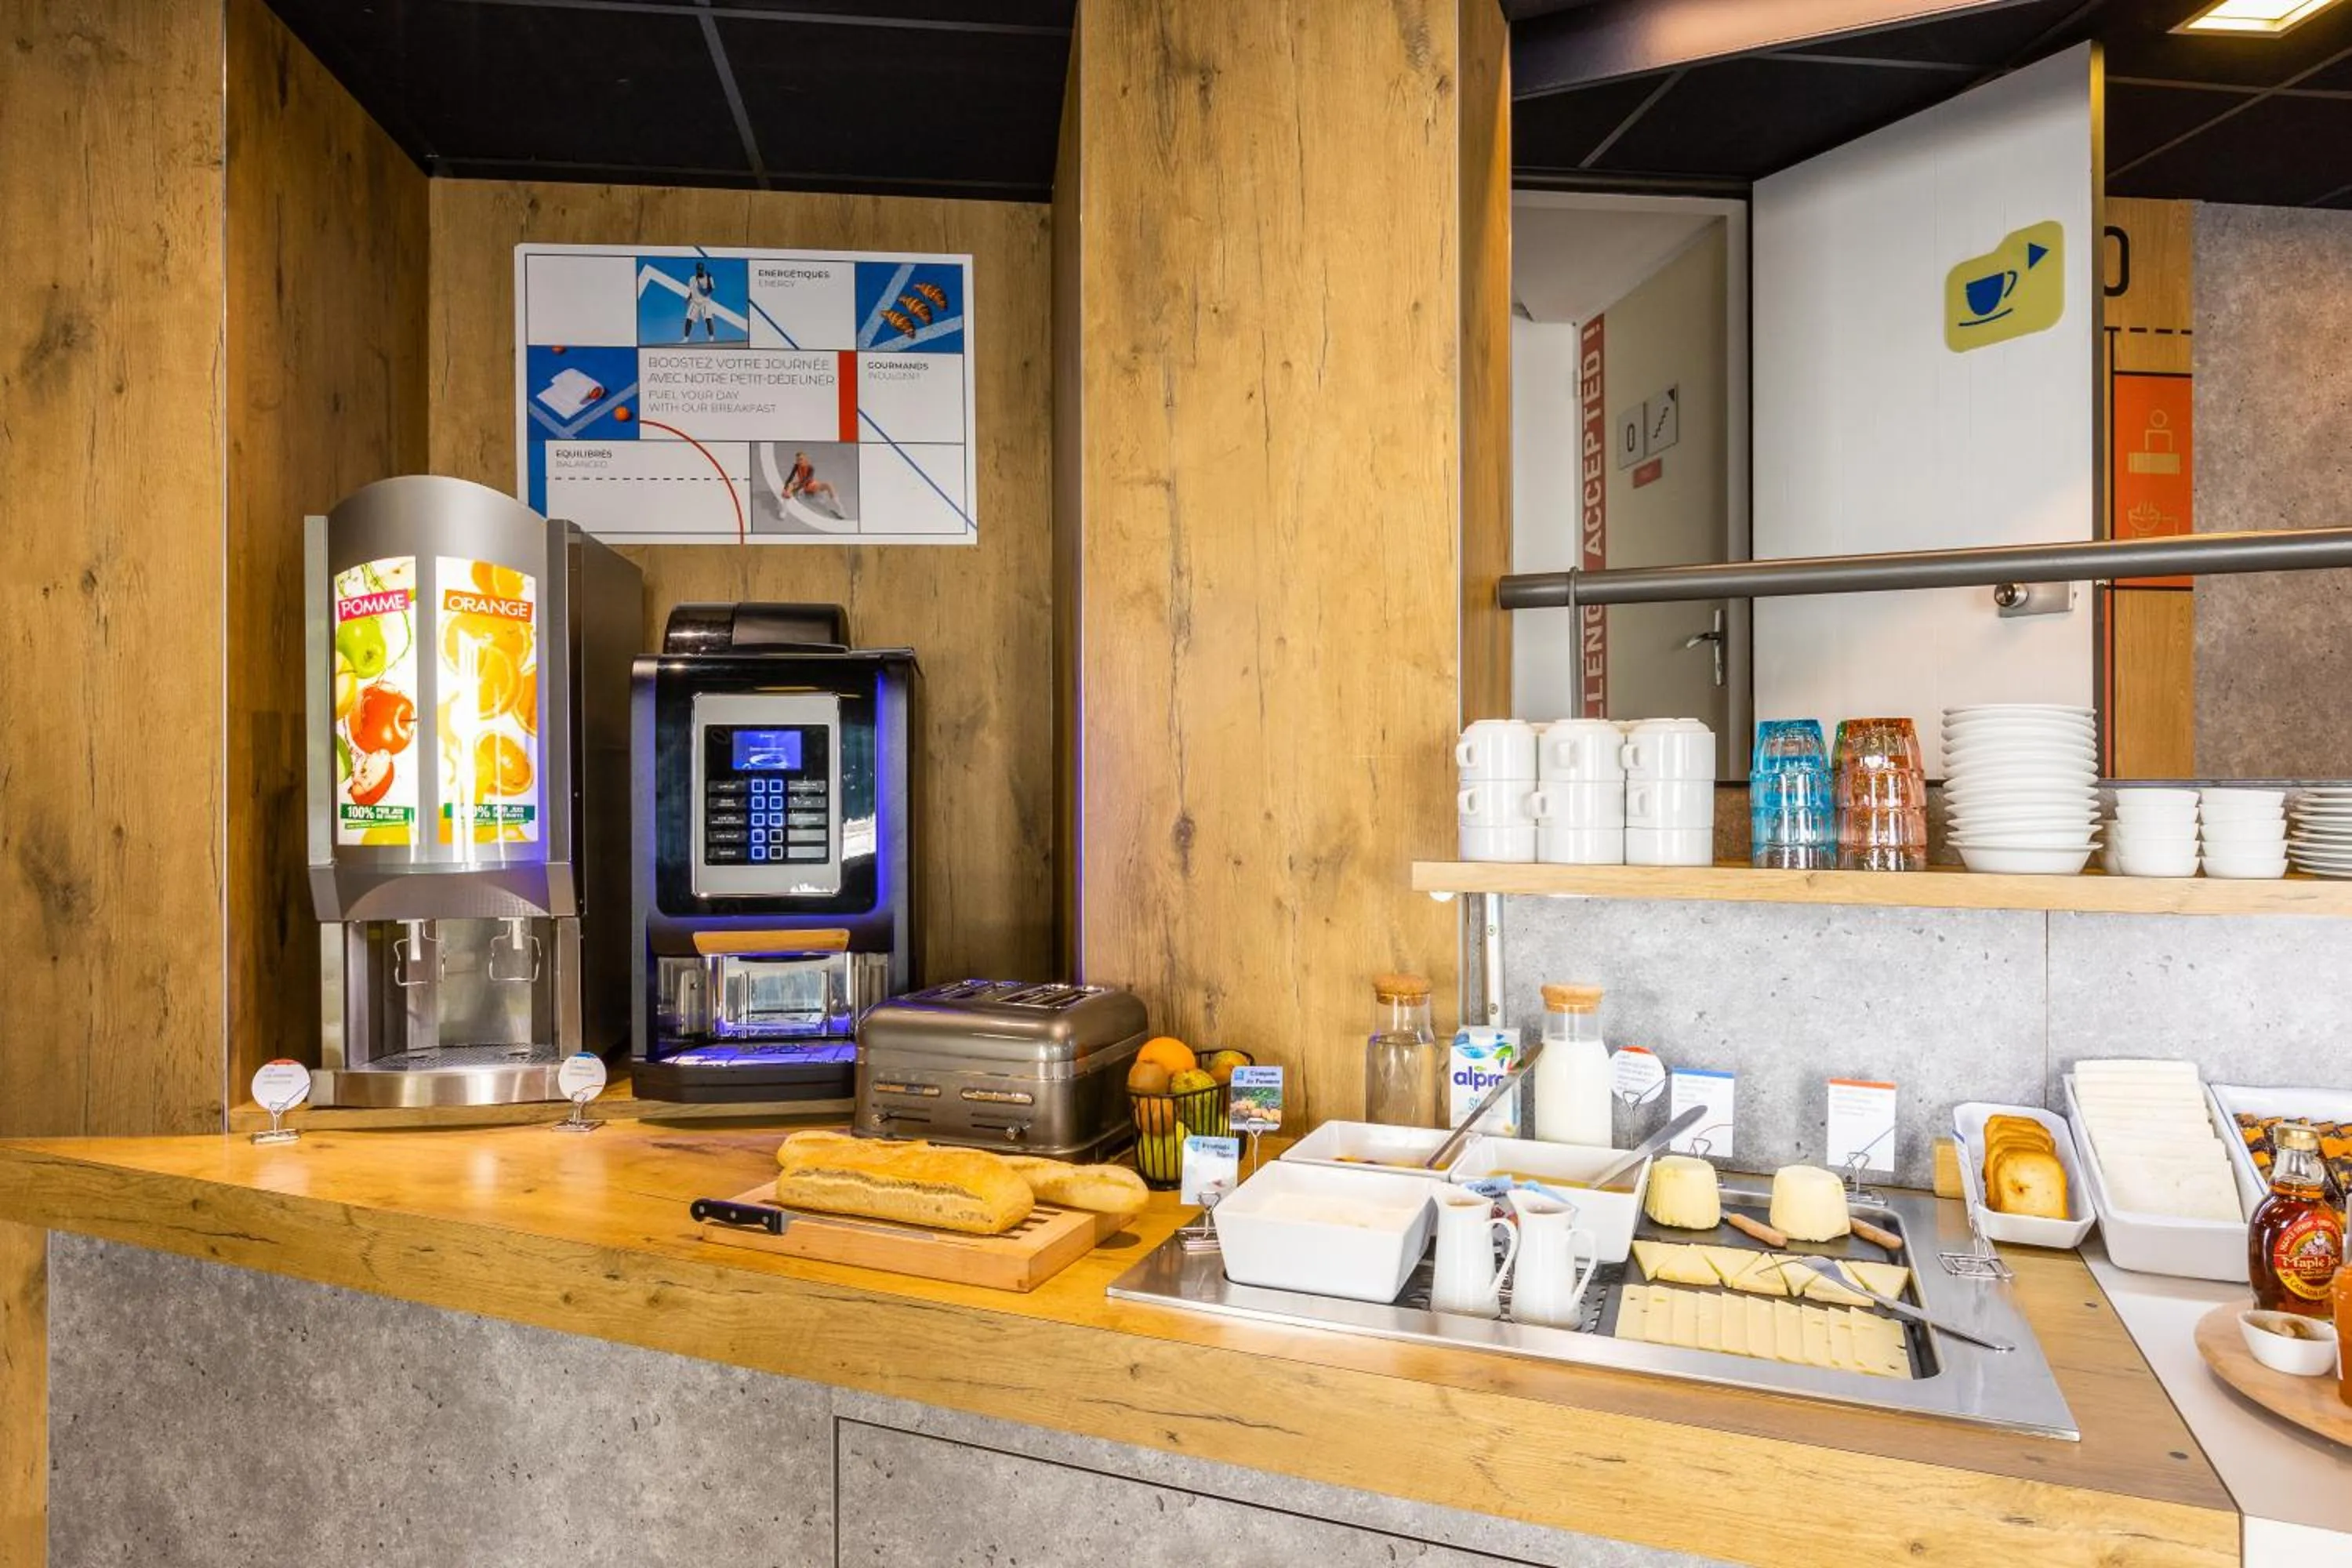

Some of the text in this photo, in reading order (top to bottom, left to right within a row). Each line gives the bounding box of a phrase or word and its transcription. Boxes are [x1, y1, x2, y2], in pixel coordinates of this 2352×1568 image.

[648, 356, 713, 369] BOOSTEZ
[716, 358, 764, 369] VOTRE
[868, 361, 929, 371] GOURMANDS
[648, 372, 682, 383] AVEC
[684, 372, 726, 384] NOTRE
[648, 390, 740, 401] FUEL YOUR DAY
[648, 402, 777, 413] WITH OUR BREAKFAST
[1583, 348, 1602, 557] ACCEPTED
[340, 593, 405, 616] POMME
[448, 595, 528, 617] ORANGE
[347, 805, 376, 819] 100%
[2282, 1256, 2326, 1270] Maple
